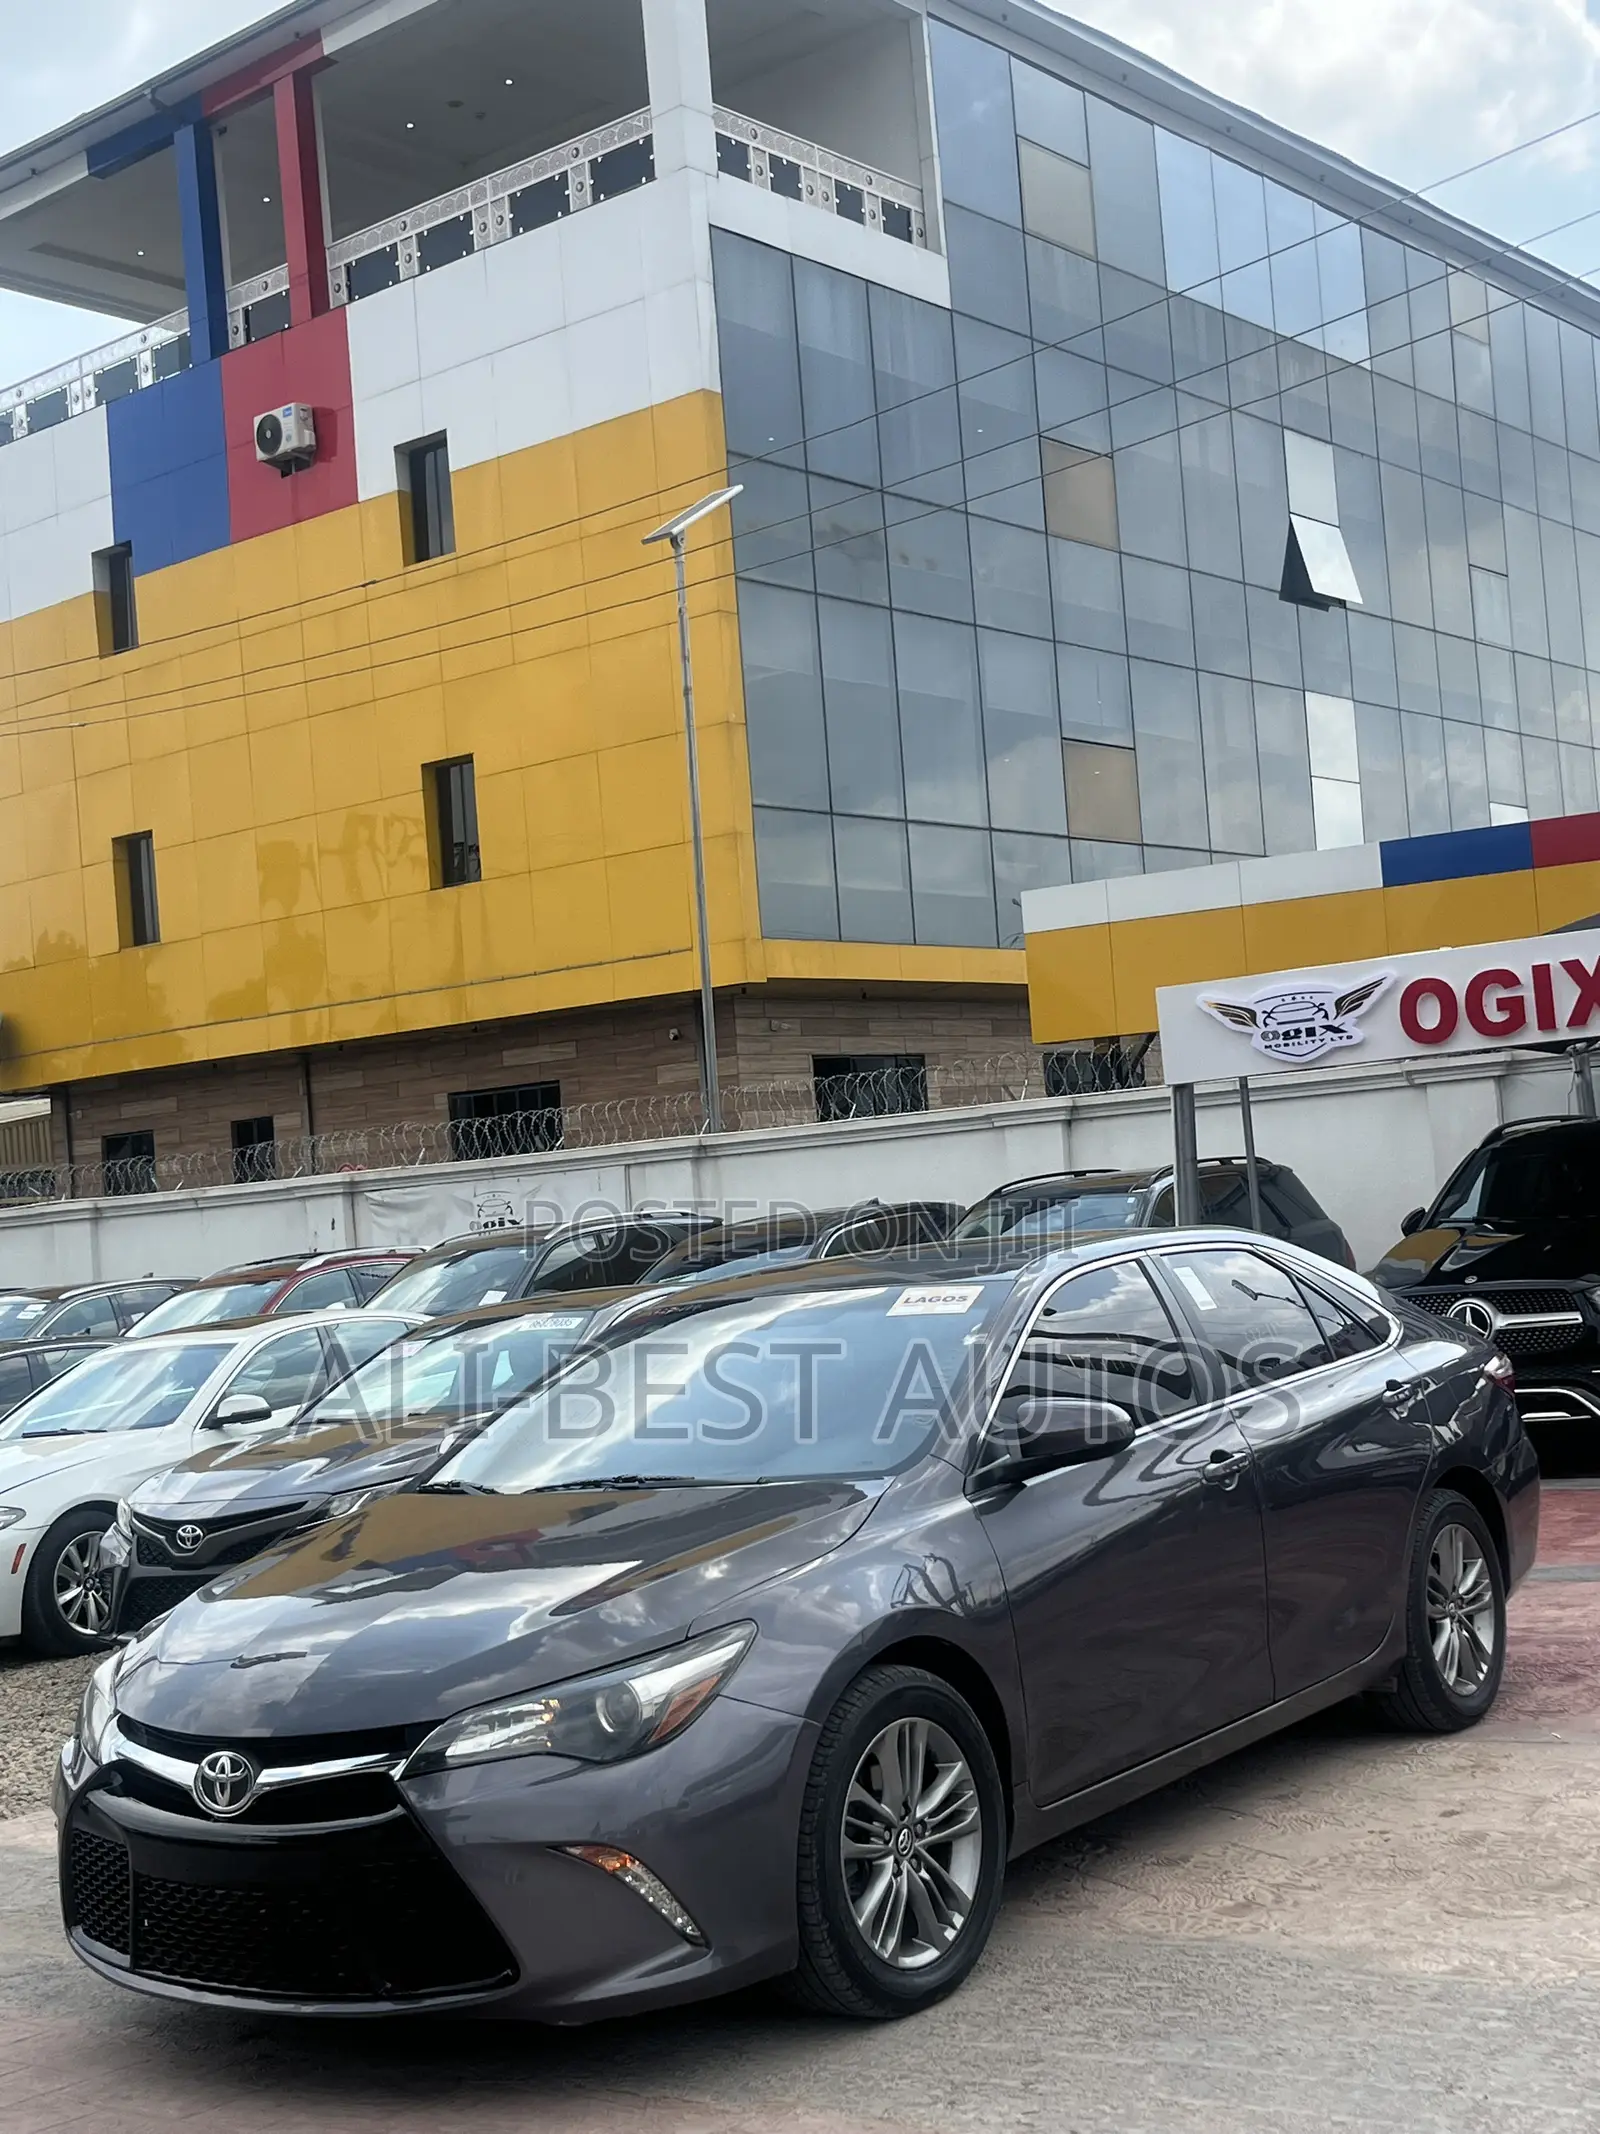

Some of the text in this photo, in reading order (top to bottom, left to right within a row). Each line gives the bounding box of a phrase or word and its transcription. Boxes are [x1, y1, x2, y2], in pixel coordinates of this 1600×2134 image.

[1400, 954, 1600, 1044] OGIX
[1264, 1034, 1353, 1049] MOBILITY LTD
[903, 1294, 969, 1304] LAGOS
